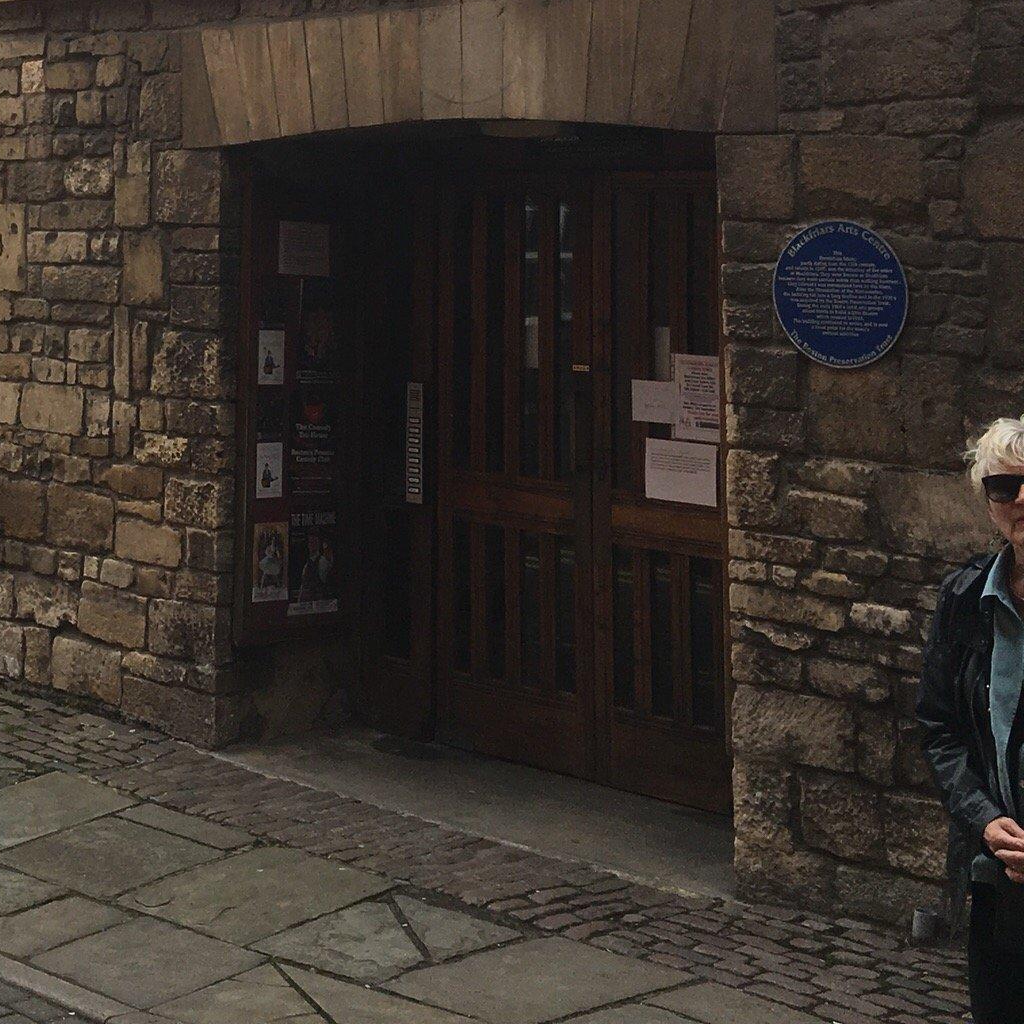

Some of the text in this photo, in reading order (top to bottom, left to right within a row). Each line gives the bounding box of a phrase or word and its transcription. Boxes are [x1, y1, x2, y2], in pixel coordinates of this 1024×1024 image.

[787, 223, 891, 261] Blackfriars Arts Centre
[829, 350, 877, 366] Preservation
